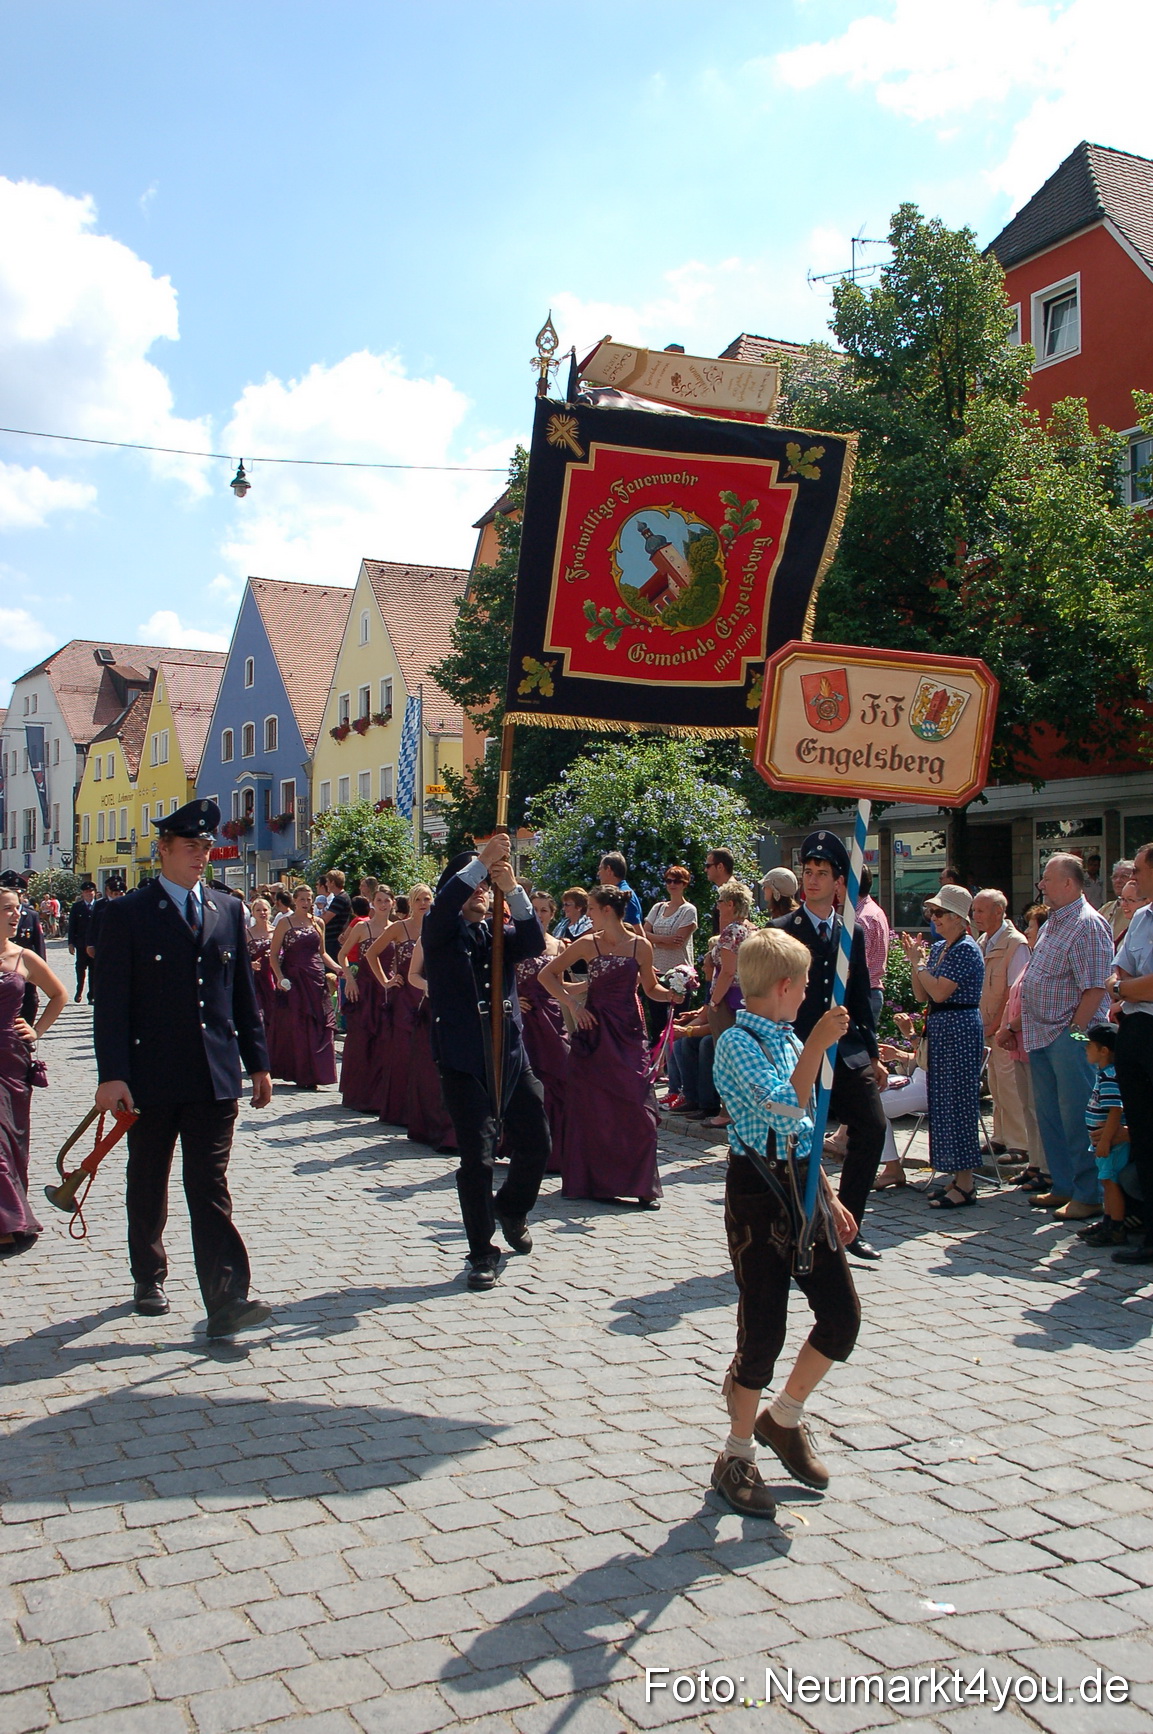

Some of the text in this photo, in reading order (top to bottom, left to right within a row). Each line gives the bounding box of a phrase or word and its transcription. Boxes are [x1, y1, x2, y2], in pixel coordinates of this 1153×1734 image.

[564, 470, 699, 584] Freiwillige Feuerwehr
[627, 536, 773, 667] Gemeinde Engelsberg
[713, 622, 758, 675] 1913-1963
[795, 737, 945, 785] Engelsberg
